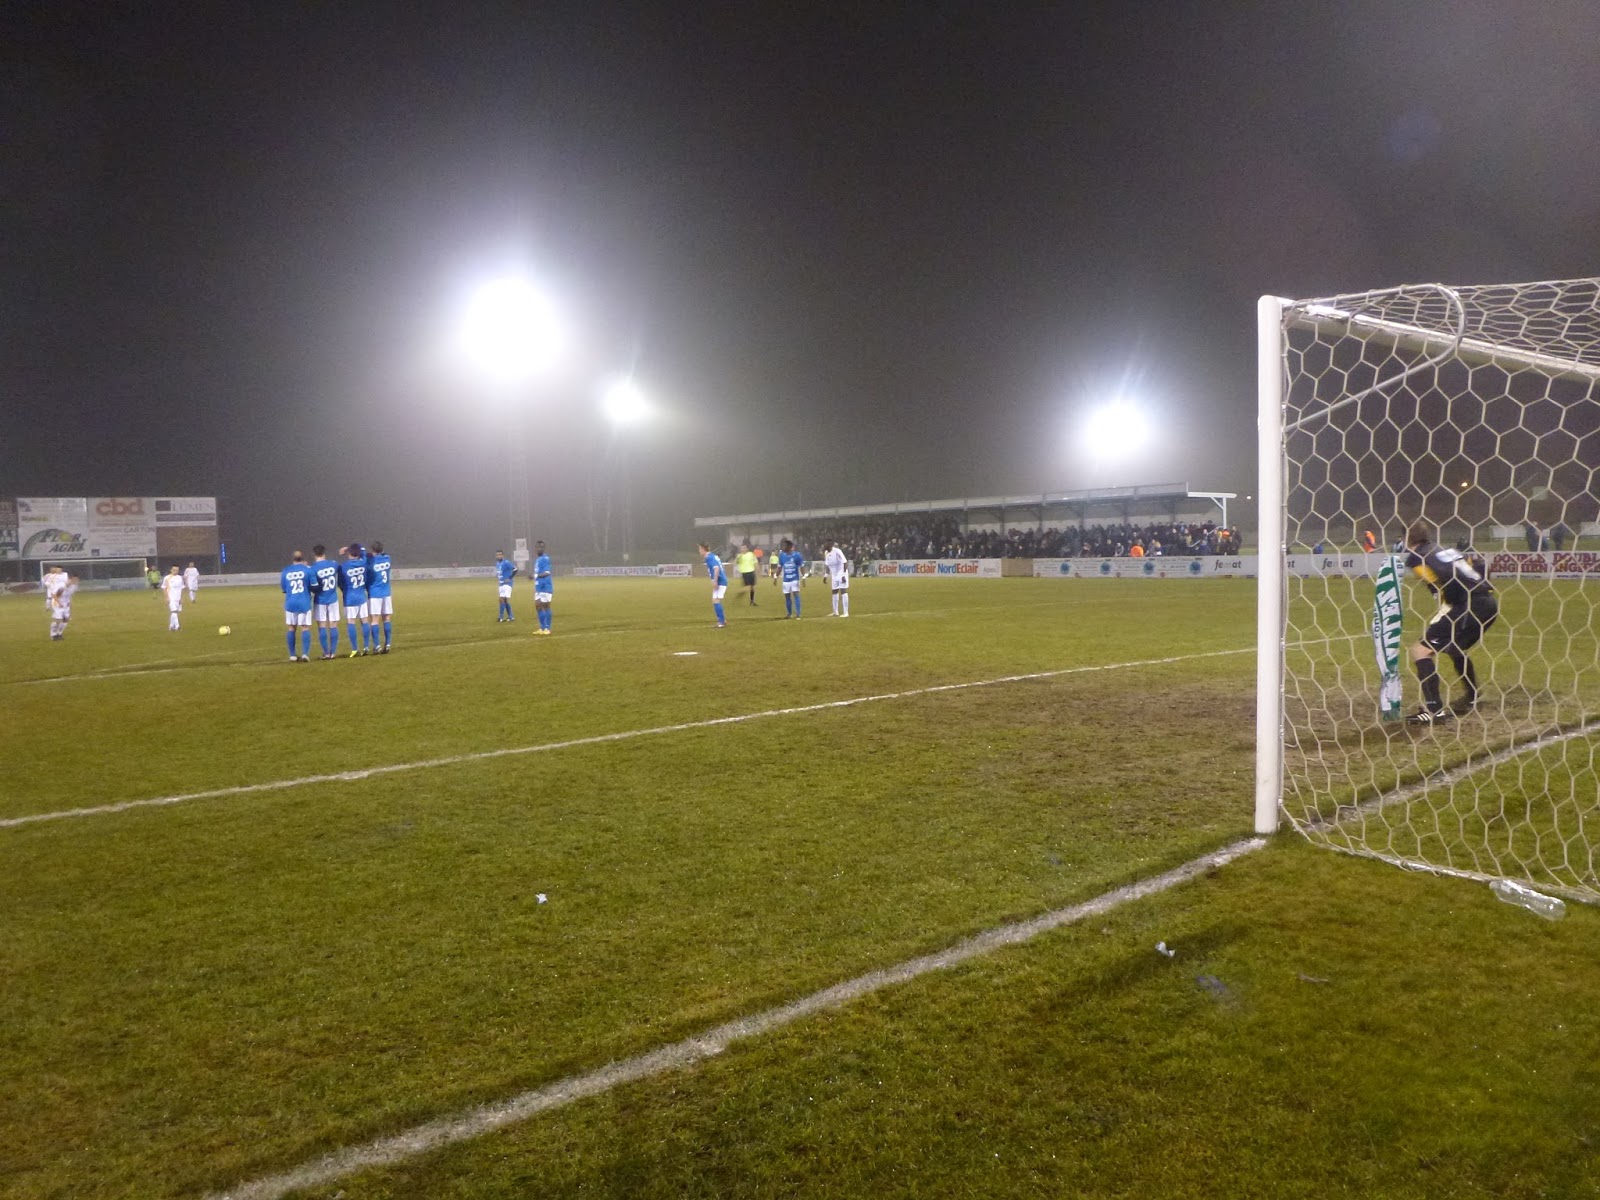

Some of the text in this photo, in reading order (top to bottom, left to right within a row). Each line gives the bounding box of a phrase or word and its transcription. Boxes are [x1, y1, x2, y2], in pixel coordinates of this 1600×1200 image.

[96, 499, 145, 516] cbd
[1553, 552, 1600, 562] DOUBL
[322, 576, 336, 591] 20
[351, 575, 365, 589] 22
[381, 571, 387, 583] 3
[290, 580, 304, 594] 23
